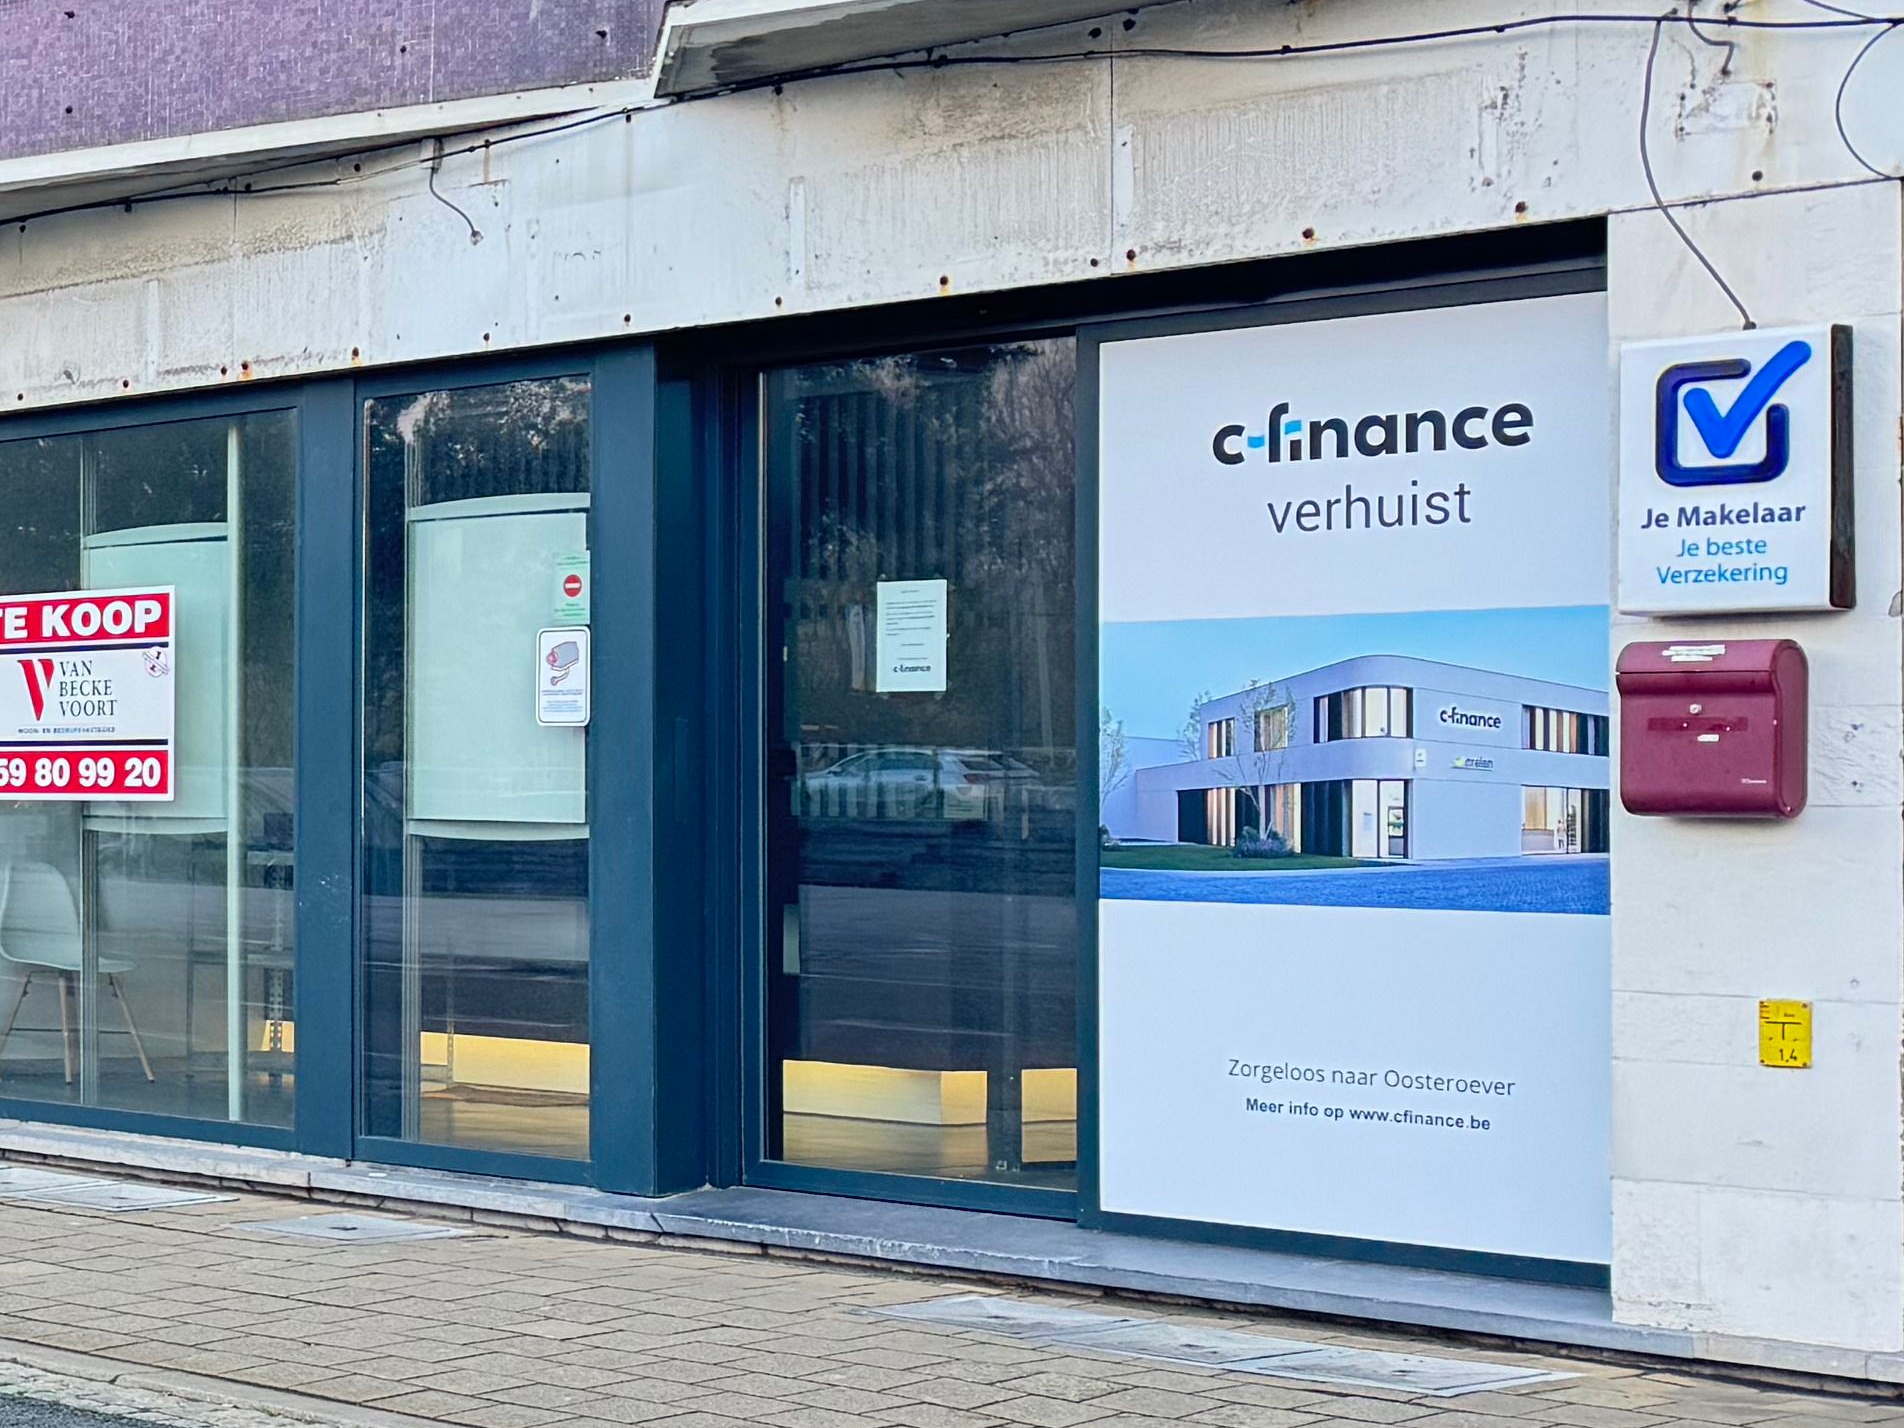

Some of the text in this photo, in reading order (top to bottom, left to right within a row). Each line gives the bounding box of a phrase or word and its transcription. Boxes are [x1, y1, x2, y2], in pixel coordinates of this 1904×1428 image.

[1267, 479, 1471, 533] verhuist
[1640, 501, 1806, 530] Je Makelaar
[1675, 535, 1768, 558] Je beste
[1656, 563, 1788, 586] Verzekering
[41, 599, 162, 638] KOOP
[59, 660, 94, 677] VAN
[59, 679, 113, 697] BECKE
[59, 699, 118, 717] VOORT
[34, 757, 71, 787] 80
[78, 757, 115, 787] 99
[124, 757, 161, 787] 20
[1228, 1058, 1516, 1096] Zorgeloos naar Oosteroever
[1246, 1098, 1491, 1131] Meer info op www.cfinance.be
